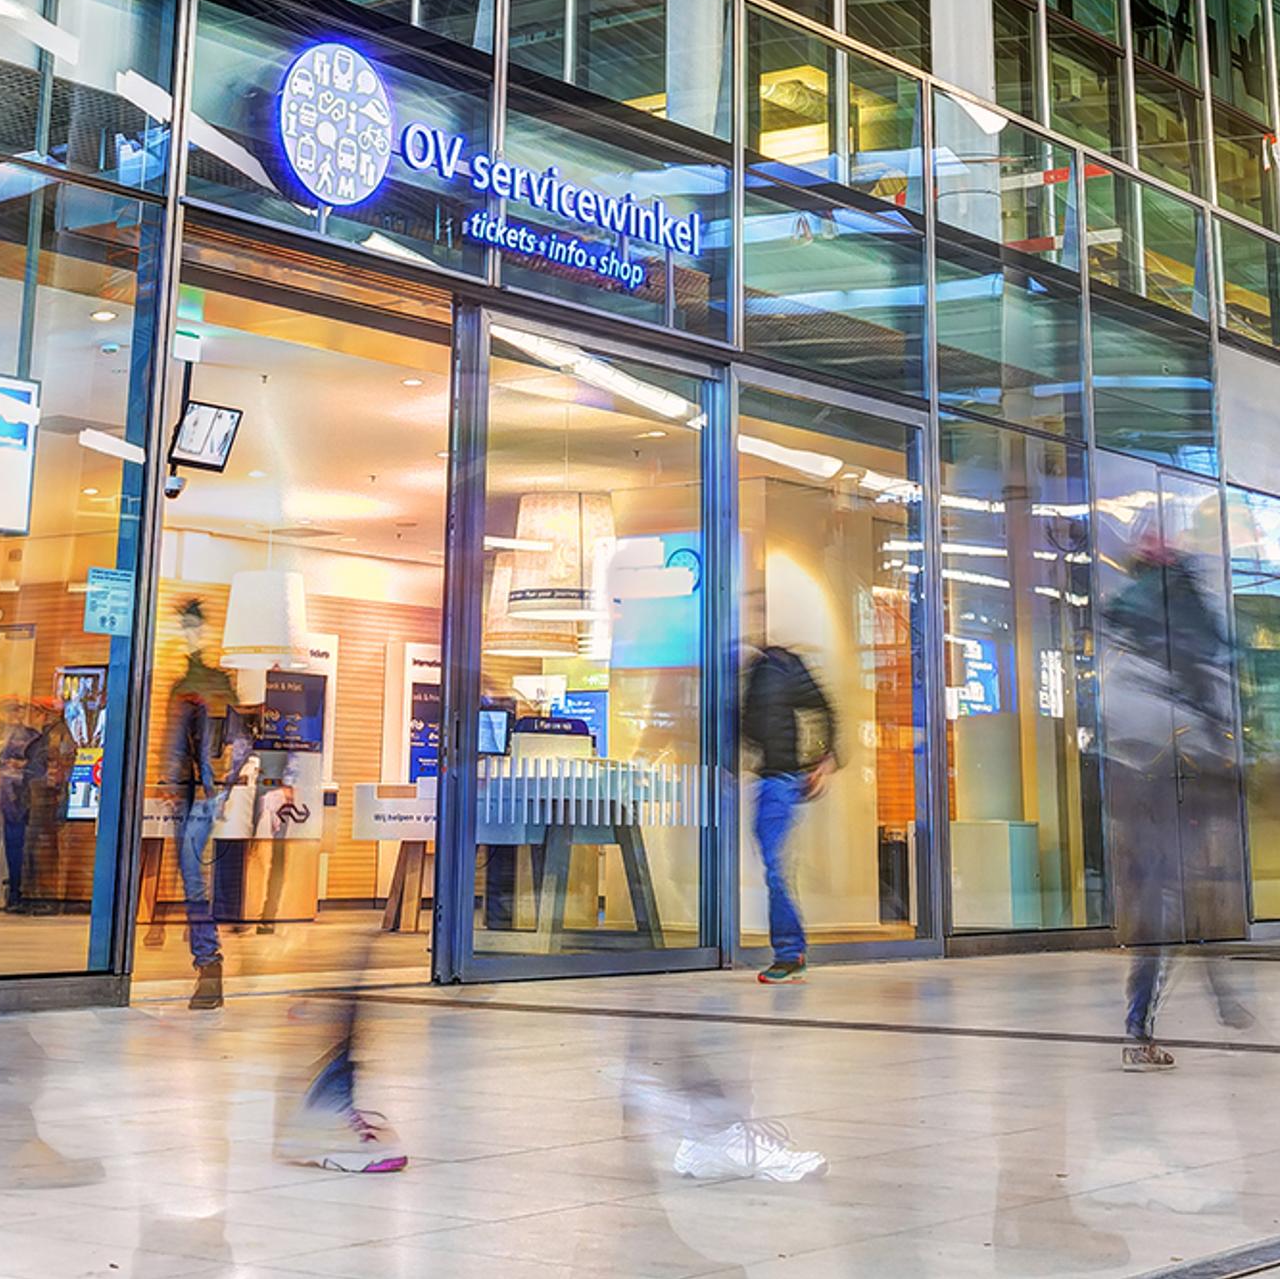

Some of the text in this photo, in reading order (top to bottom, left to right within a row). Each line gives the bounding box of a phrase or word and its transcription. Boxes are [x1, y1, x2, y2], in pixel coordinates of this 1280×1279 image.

[404, 122, 701, 256] OV servicewinkel
[471, 212, 645, 287] tickets info shop
